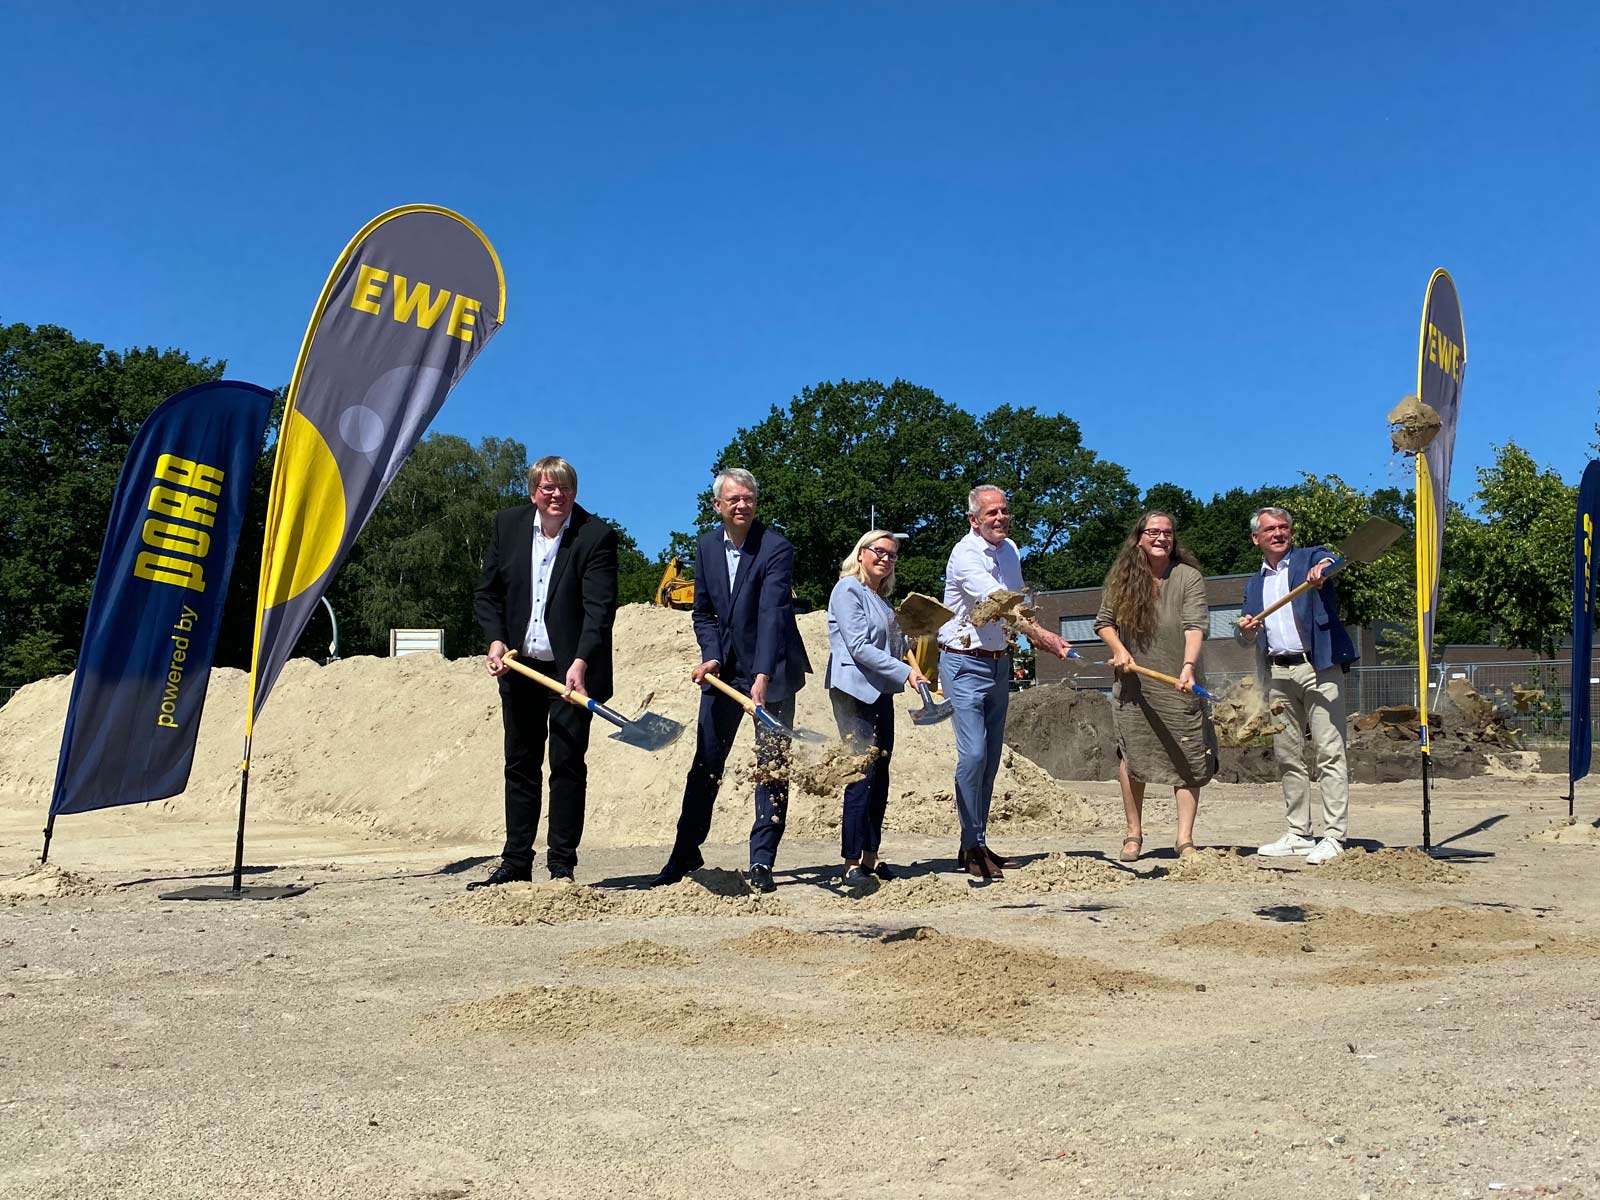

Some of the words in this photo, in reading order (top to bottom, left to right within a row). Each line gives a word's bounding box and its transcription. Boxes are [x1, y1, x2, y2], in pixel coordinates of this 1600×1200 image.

[351, 264, 481, 343] EWE
[1429, 322, 1461, 384] EWE
[134, 453, 225, 593] PORR
[173, 604, 199, 632] by
[157, 635, 190, 729] powered
